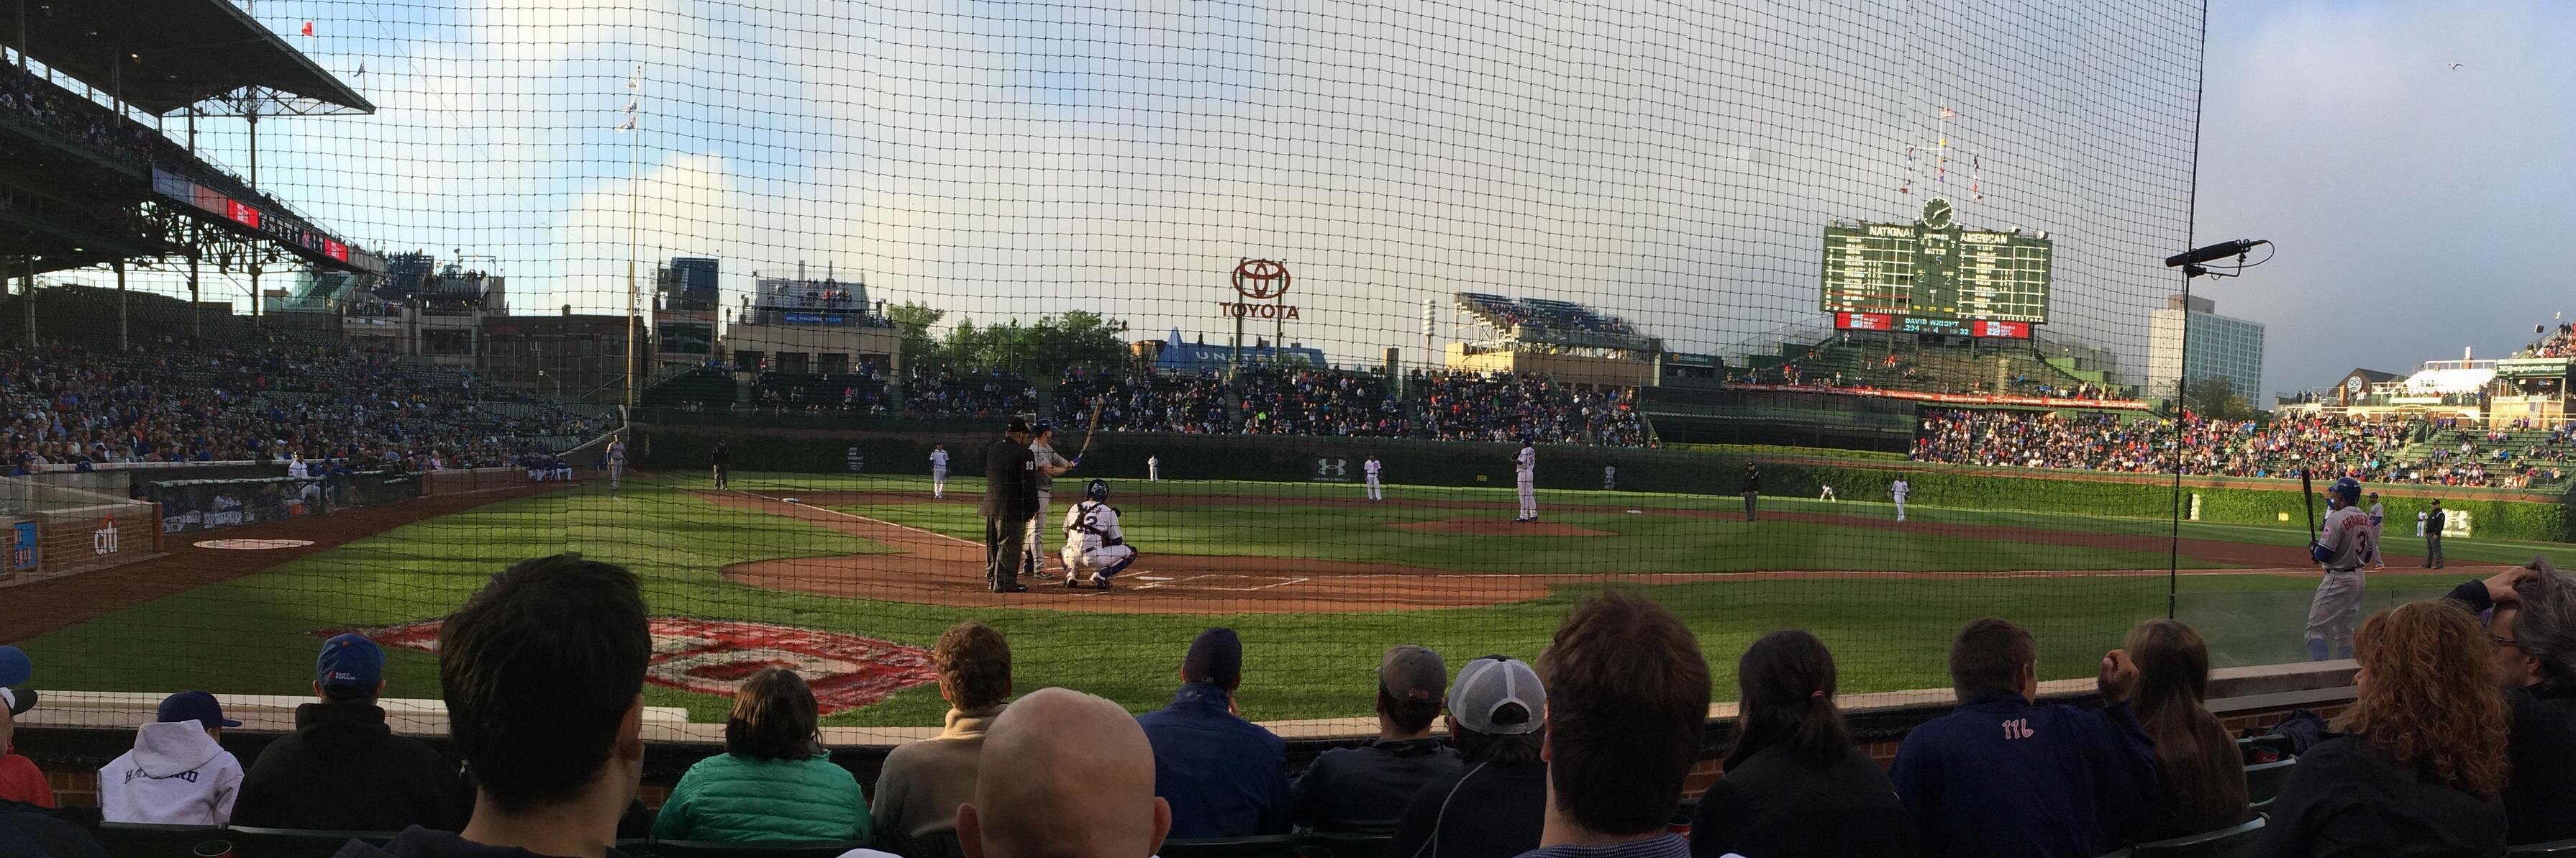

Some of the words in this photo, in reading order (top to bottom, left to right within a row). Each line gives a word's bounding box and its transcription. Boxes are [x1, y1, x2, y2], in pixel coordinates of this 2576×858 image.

[1870, 226, 1916, 237] NATIONAL
[1960, 232, 2008, 244] AMERICAN
[1219, 302, 1300, 320] TOYOTA
[1026, 460, 1034, 470] 13
[94, 520, 118, 555] citi
[2356, 531, 2366, 555] 3
